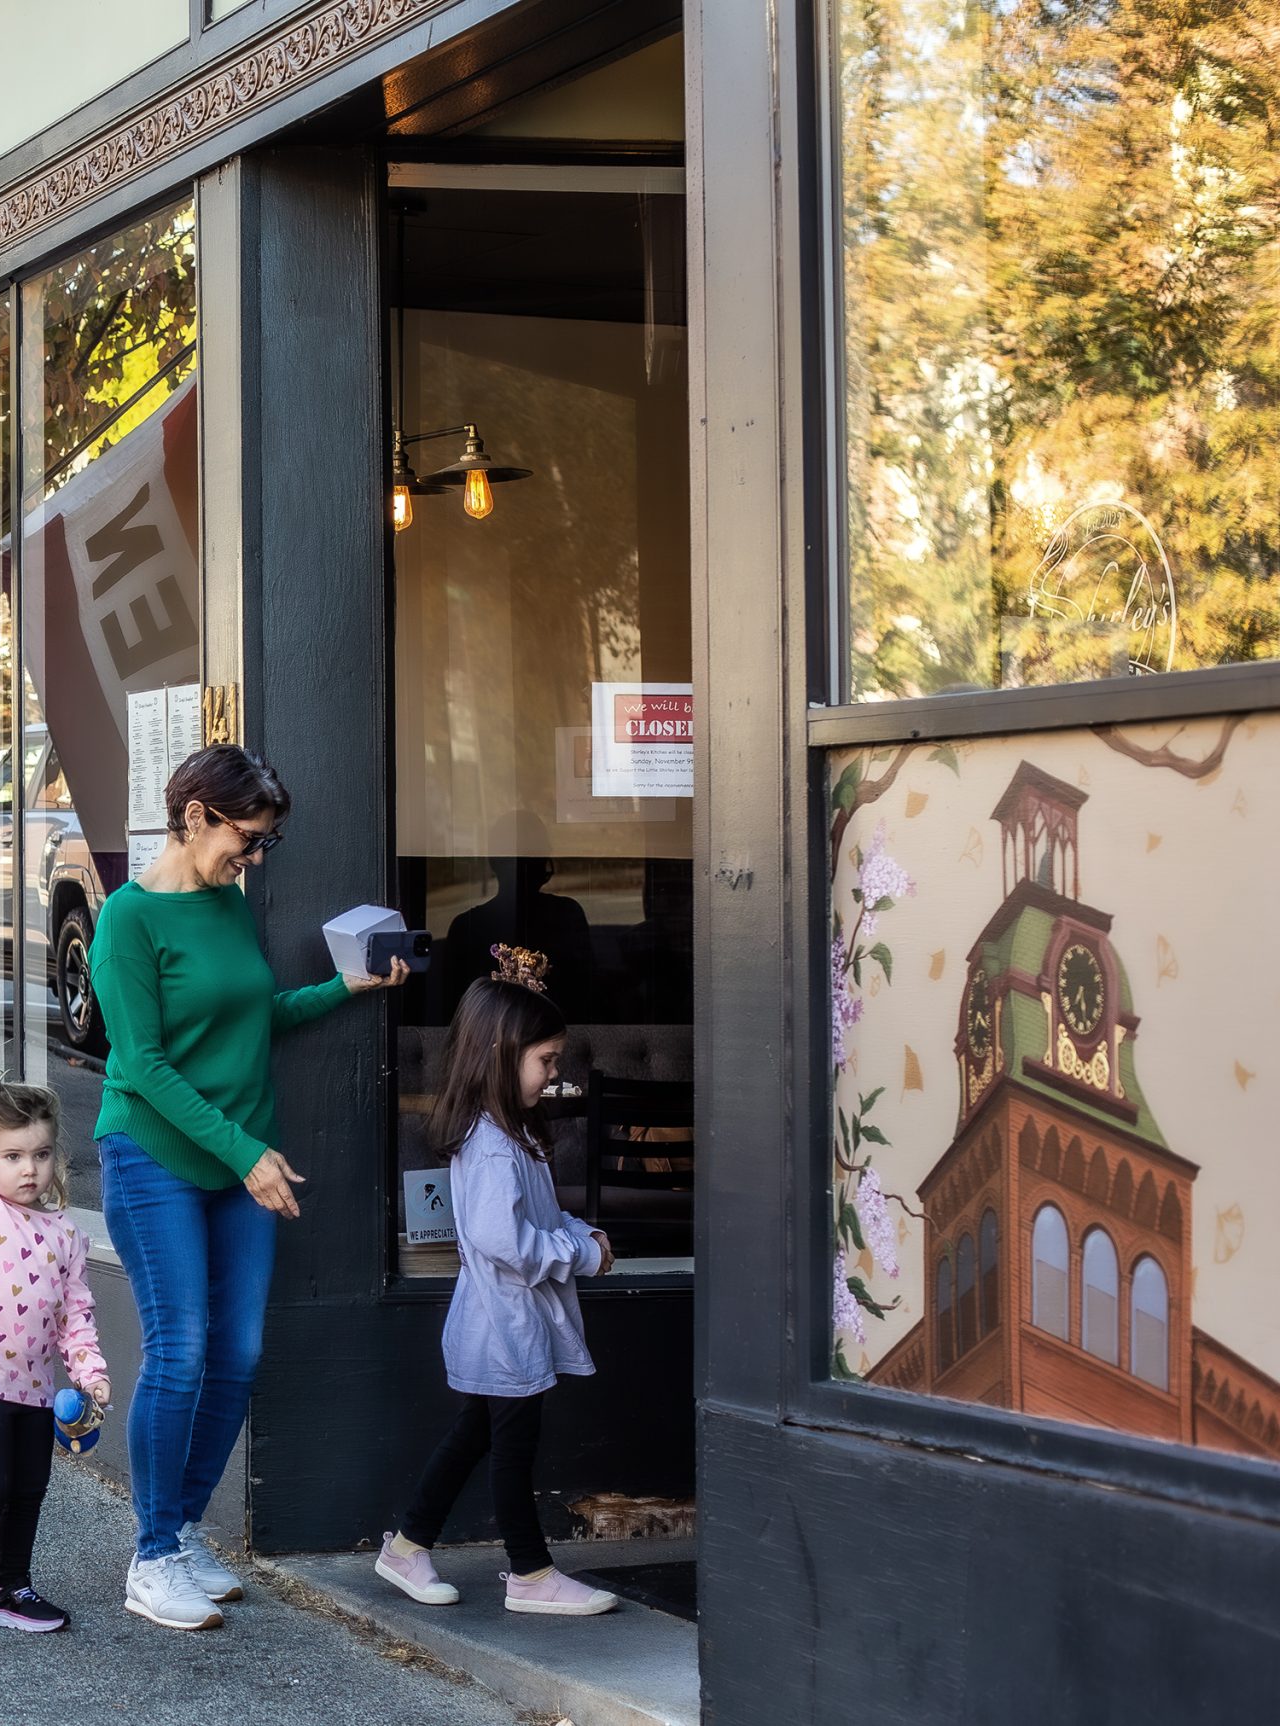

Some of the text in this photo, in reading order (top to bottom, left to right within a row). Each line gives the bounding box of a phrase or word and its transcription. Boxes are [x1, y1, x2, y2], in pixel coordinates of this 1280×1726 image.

[1100, 510, 1121, 530] 2023
[651, 700, 679, 711] will
[684, 702, 693, 713] b
[410, 1231, 419, 1240] WE
[420, 1228, 454, 1240] APPRECIATE
